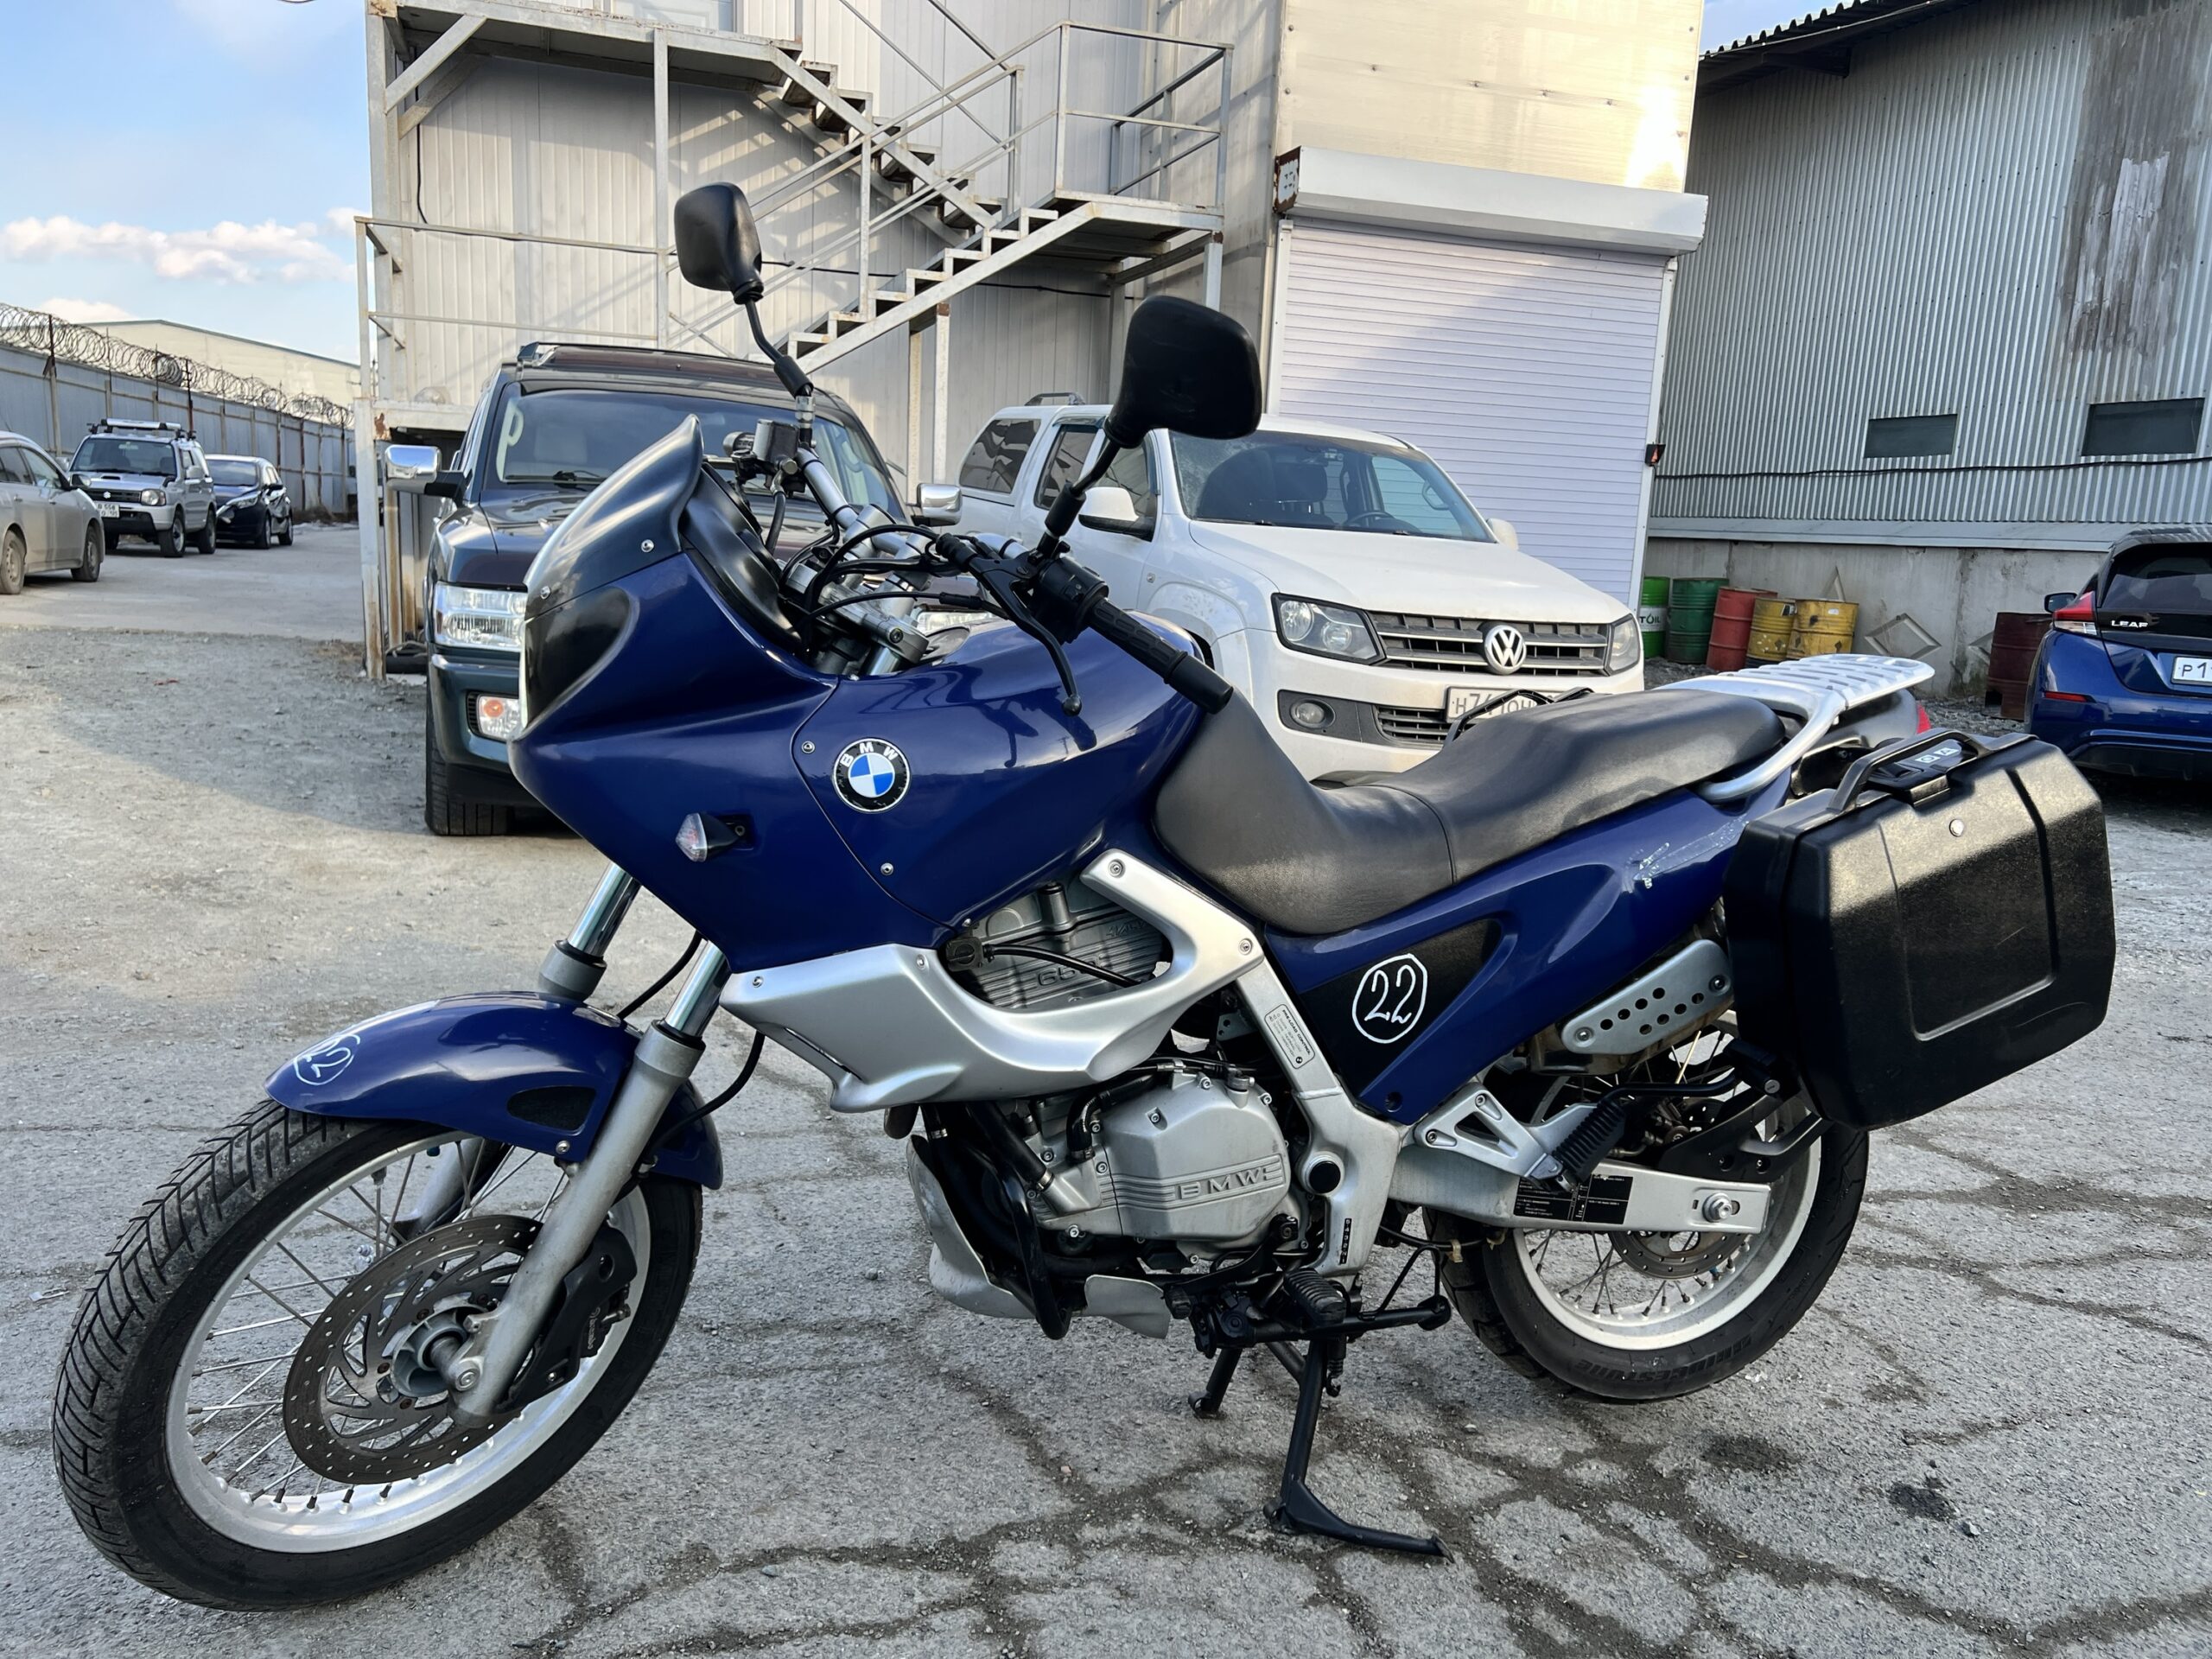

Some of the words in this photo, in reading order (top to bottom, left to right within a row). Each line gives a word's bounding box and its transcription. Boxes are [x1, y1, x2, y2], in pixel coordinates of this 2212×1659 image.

[2111, 620, 2149, 629] LEAF
[840, 741, 899, 767] BMW
[1364, 964, 1416, 1024] 22
[1179, 1166, 1262, 1200] BMW
